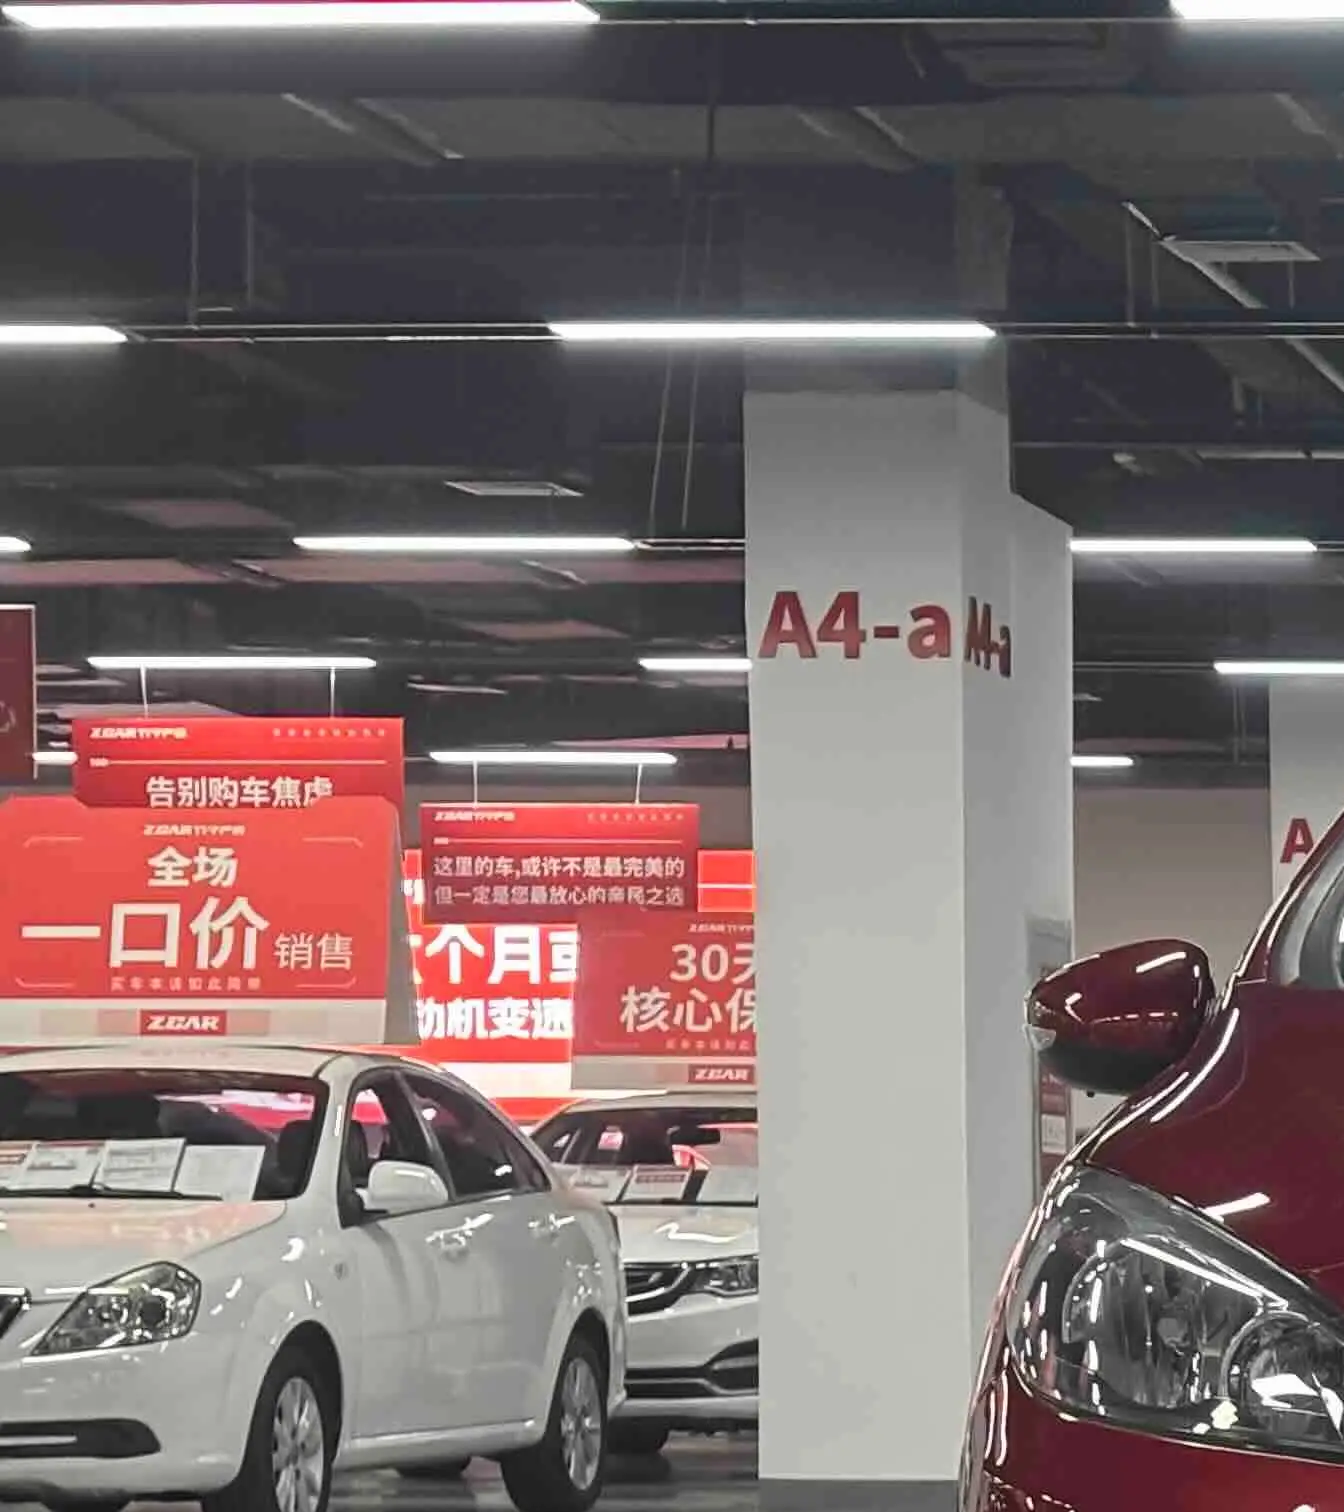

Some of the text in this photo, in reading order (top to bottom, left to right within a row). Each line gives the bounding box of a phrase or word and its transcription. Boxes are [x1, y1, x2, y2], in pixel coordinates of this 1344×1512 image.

[758, 590, 951, 660] A4-a
[147, 845, 239, 887] 全场
[21, 896, 354, 970] 一口价 销售
